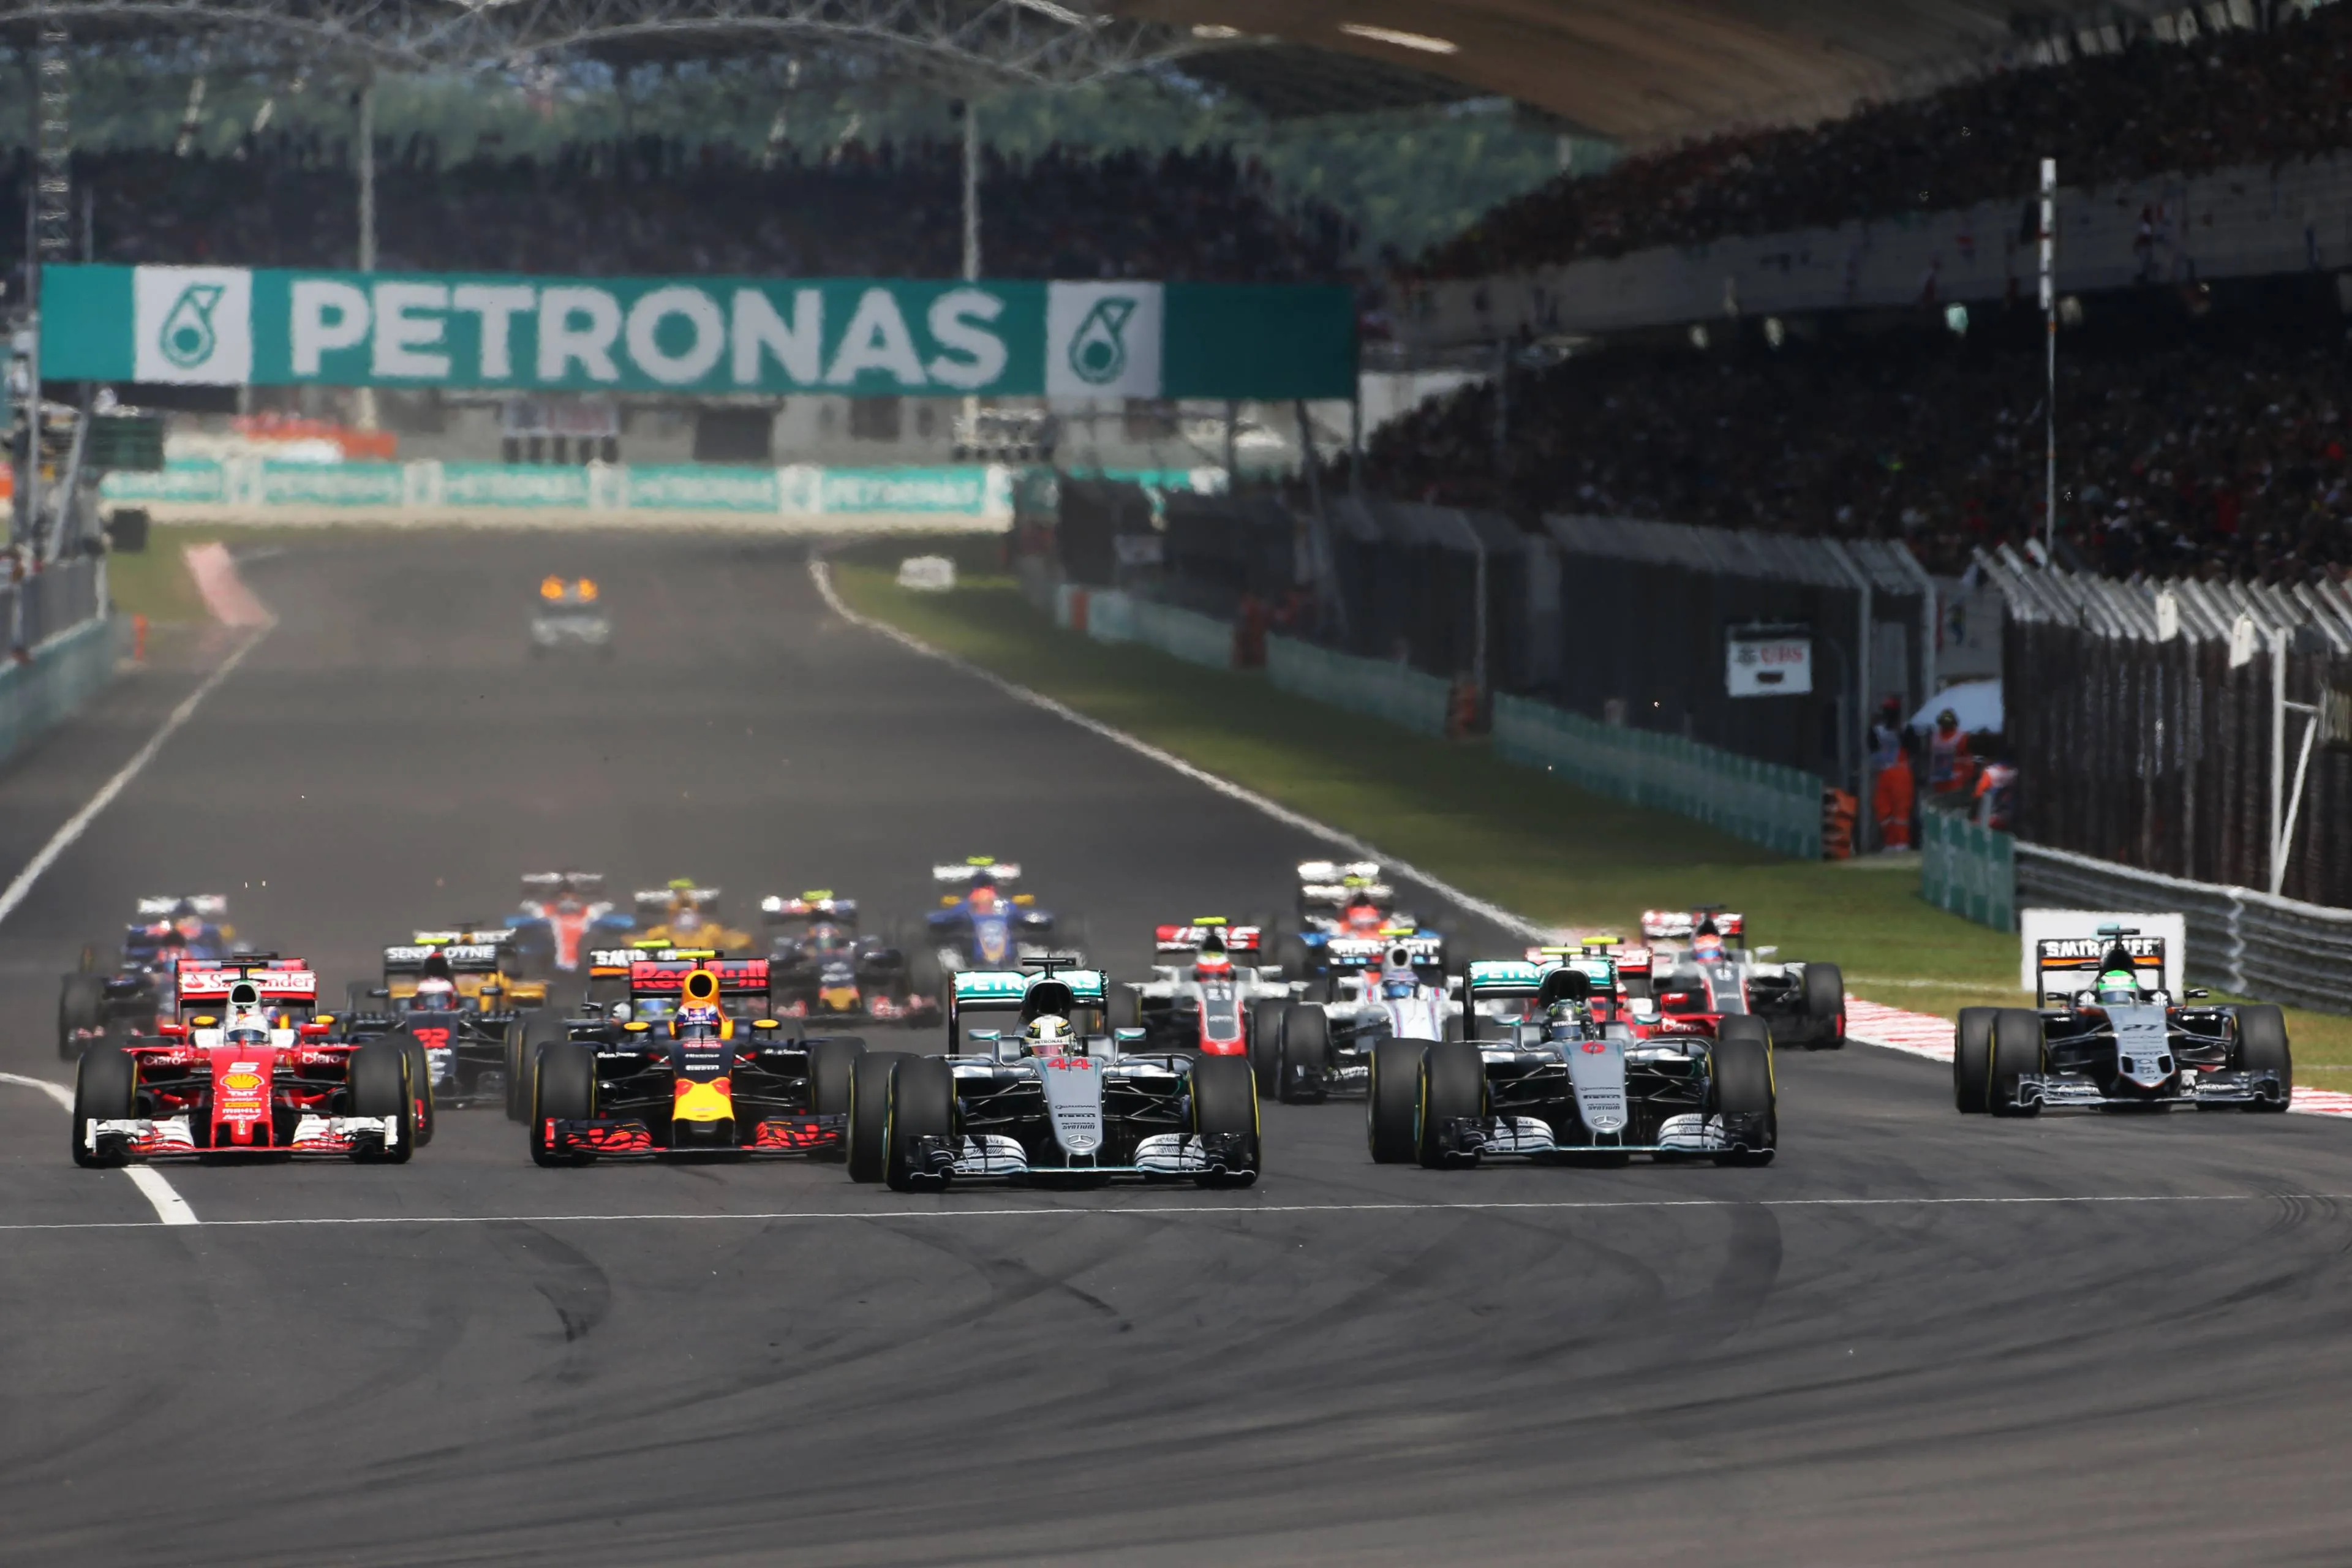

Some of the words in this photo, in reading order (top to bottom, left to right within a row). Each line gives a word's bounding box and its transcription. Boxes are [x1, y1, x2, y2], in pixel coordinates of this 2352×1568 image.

[290, 280, 1008, 388] PETRONAS
[209, 973, 313, 989] Saander
[143, 1055, 181, 1066] Claro
[303, 1052, 341, 1064] Claro
[1047, 1058, 1093, 1070] 44
[227, 1061, 260, 1073] 5
